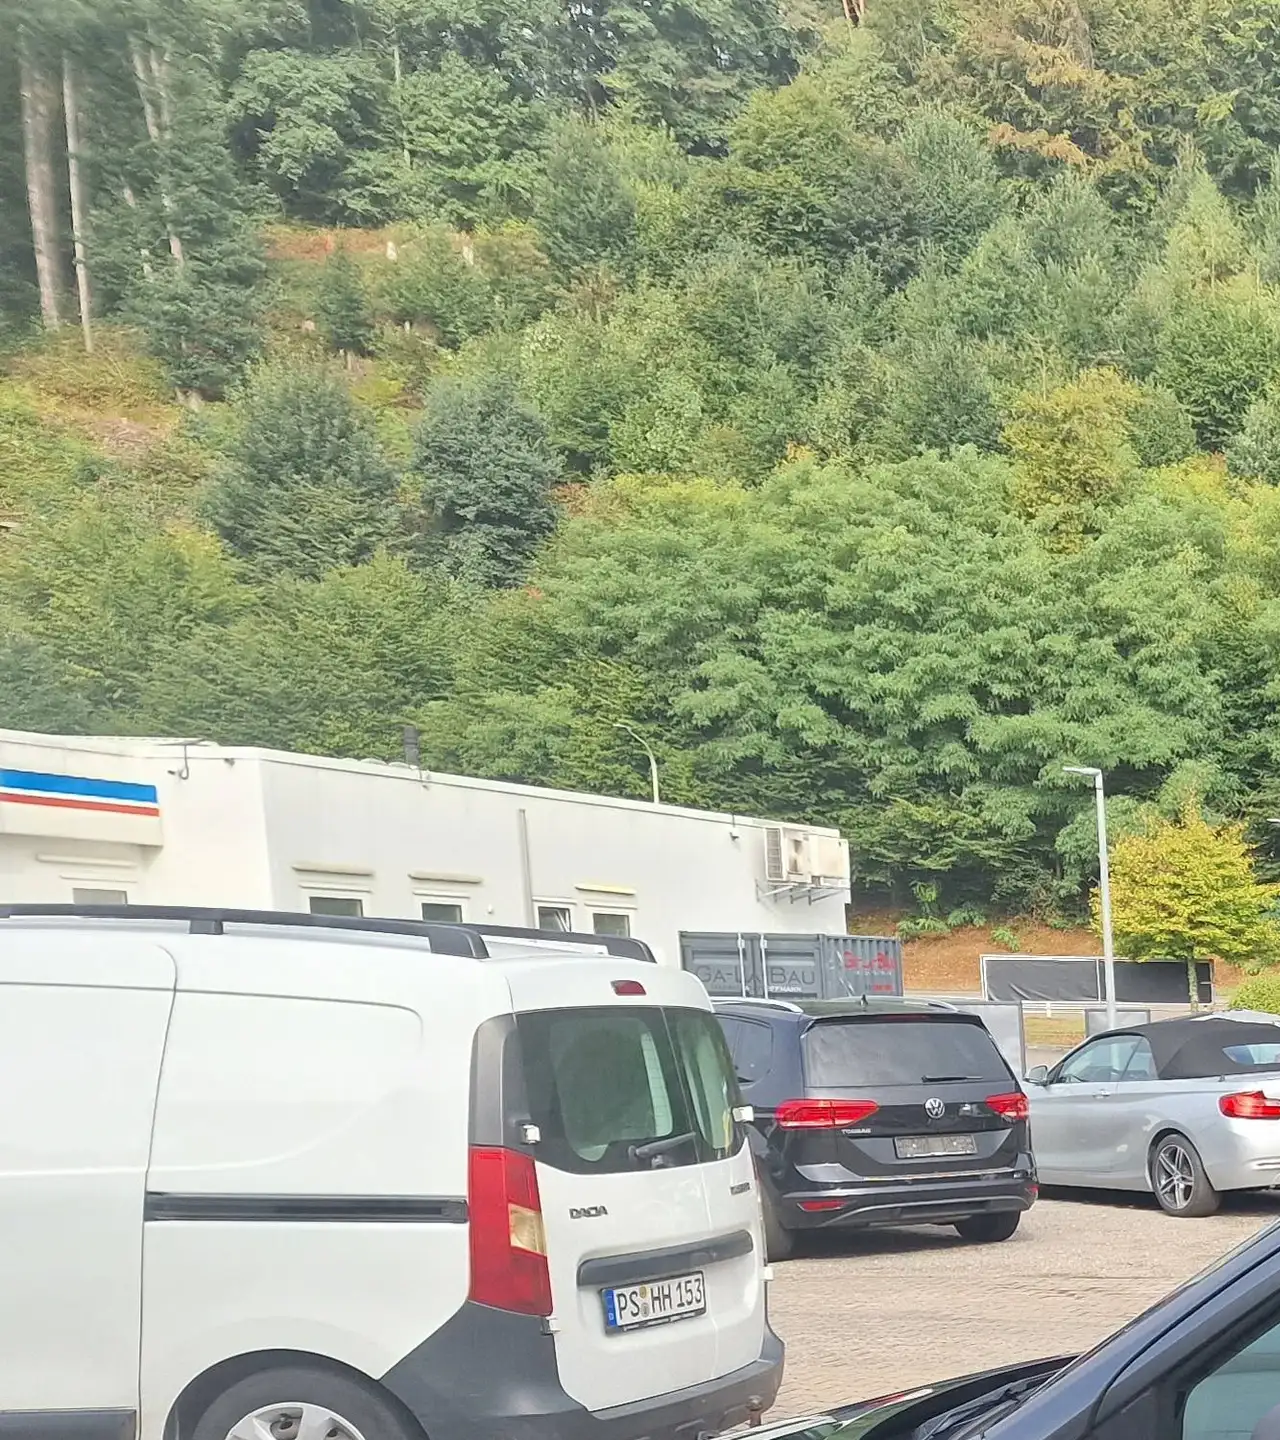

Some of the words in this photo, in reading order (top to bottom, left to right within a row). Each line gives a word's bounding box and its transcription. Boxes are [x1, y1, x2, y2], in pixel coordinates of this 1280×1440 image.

[770, 967, 815, 984] BAU
[569, 1206, 608, 1219] DACIA
[616, 1290, 641, 1320] PS
[650, 1284, 673, 1314] HH
[676, 1278, 703, 1308] 153
